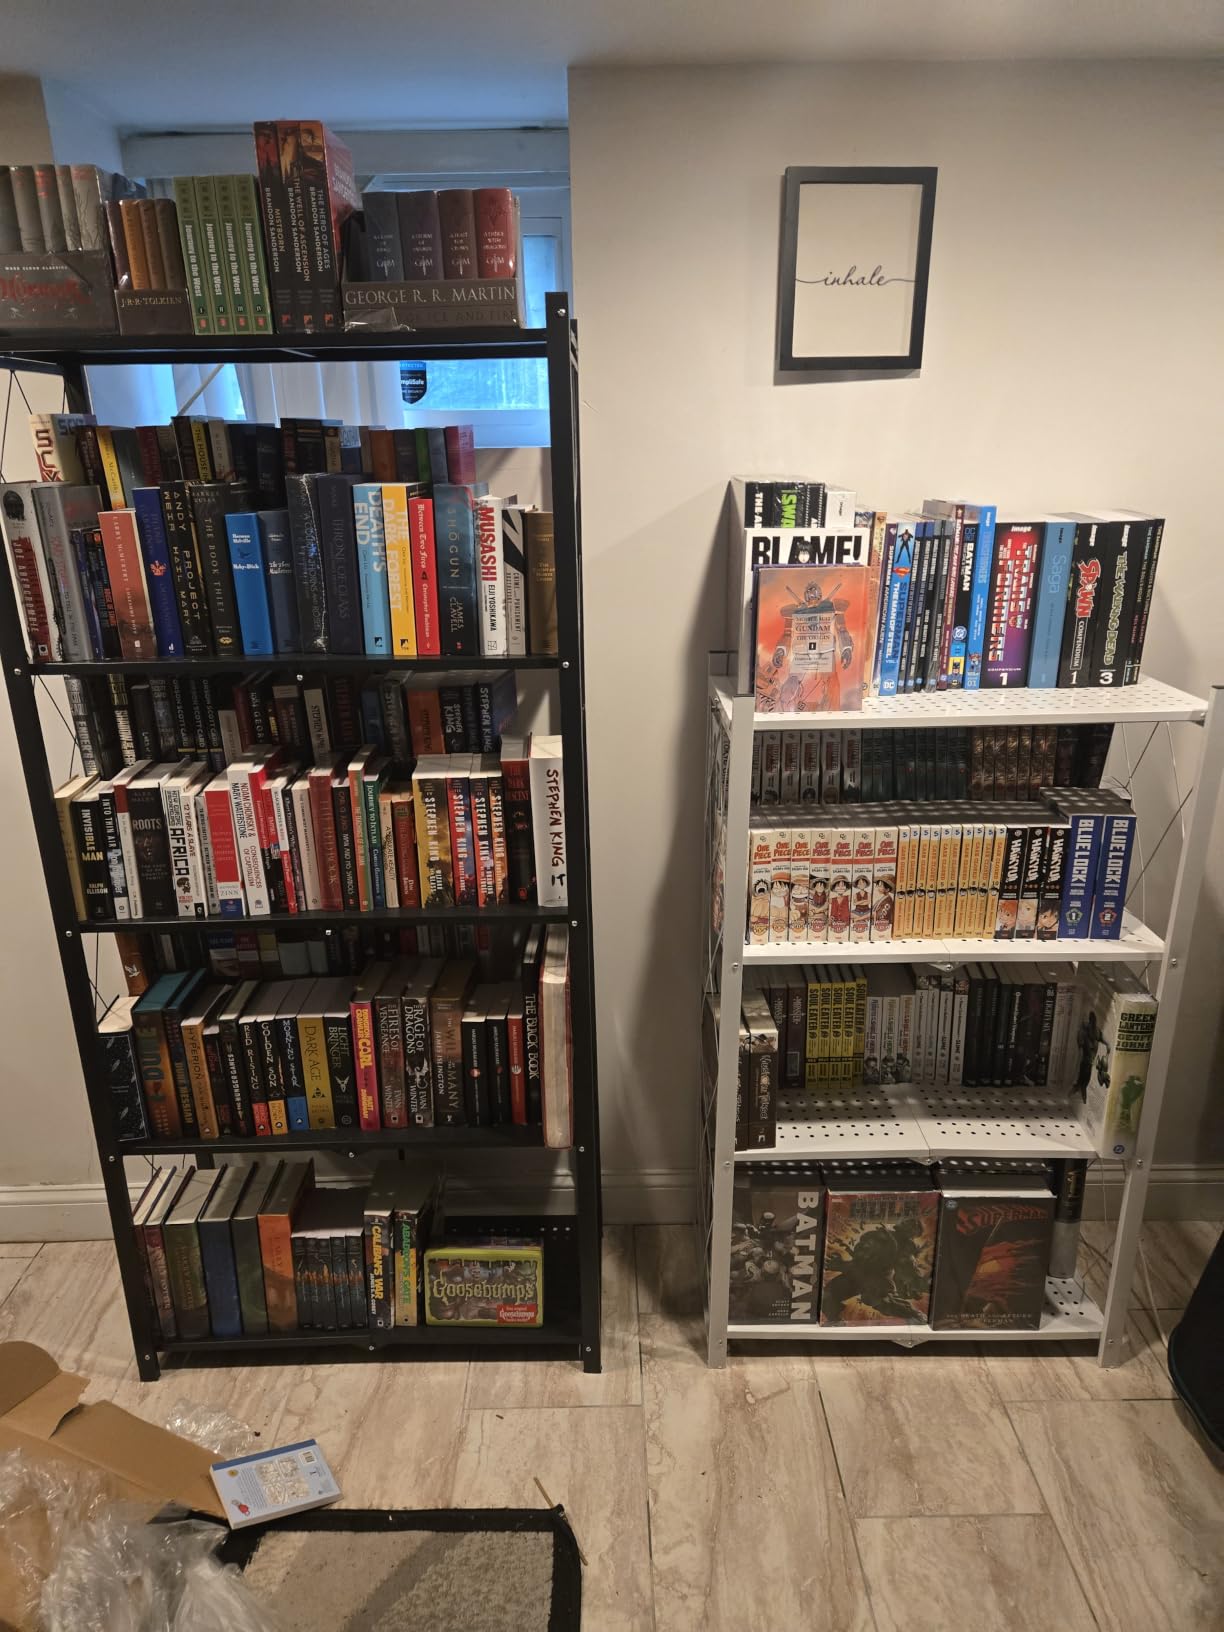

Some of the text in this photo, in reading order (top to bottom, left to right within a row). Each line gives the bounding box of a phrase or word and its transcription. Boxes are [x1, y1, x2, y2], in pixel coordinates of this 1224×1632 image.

[265, 187, 281, 273] BRANDON SANDERSON
[274, 208, 286, 252] MISTBORN
[287, 187, 303, 273] BRANDON SANDERSON
[310, 186, 324, 272] BRANDON SANDERSON
[204, 223, 222, 295] Journey West
[224, 223, 242, 295] Journey West
[244, 223, 261, 295] Journey West
[300, 234, 312, 282] ASCENSION
[323, 248, 331, 269] AGES
[345, 285, 517, 306] GEORGE R. R. MARTIN
[162, 490, 176, 531] WEIR
[173, 491, 187, 531] ANDY
[353, 502, 370, 545] END
[754, 492, 764, 513] THE
[367, 490, 386, 573] DEATH'S
[478, 507, 498, 582] MUSASHI
[752, 535, 862, 565] BLAME!
[203, 517, 225, 613] THE BOOK THIEF
[384, 499, 402, 612] DARK FOREST
[885, 545, 896, 586] SUPERMAN
[962, 542, 975, 591] BATMAN
[1048, 554, 1068, 594] Saga
[172, 546, 192, 626] HAIL MARY
[183, 550, 200, 620] PROJECT
[1076, 558, 1101, 619] SPAWN
[449, 596, 459, 632] CLAVELL
[488, 597, 497, 632] YOSHIKAWA
[795, 624, 831, 632] GUNDAM
[894, 581, 908, 659] SUPERMAN
[987, 559, 1014, 662] FORMERS
[1103, 551, 1129, 665] THE WALKING DEAD
[1073, 620, 1085, 667] COMPENDIUM
[882, 681, 895, 689] DC
[999, 672, 1009, 685] 1
[1070, 671, 1078, 684] 1
[1099, 672, 1113, 684] 3
[444, 706, 456, 733] KING
[452, 704, 463, 733] STEPHEN
[480, 687, 493, 752] STEPHEN KING
[101, 798, 115, 848] INTO THIN AIR
[132, 818, 162, 831] ROOTS
[235, 800, 247, 839] WATERSTONE
[240, 783, 254, 830] NOAM CHOMSKY
[453, 794, 468, 858] STEPHEN KING
[491, 795, 505, 858] STEPHEN KING
[546, 769, 565, 867] STEPHEN KING
[81, 809, 95, 852] INVISIBLE
[424, 797, 440, 861] STEPHEN KING
[474, 797, 491, 860] STEPHEN KING
[82, 852, 104, 862] MAN
[170, 828, 189, 876] AFRICA
[774, 849, 791, 857] PIECE
[792, 849, 810, 857] PIECE
[360, 1008, 371, 1038] DUNGEON
[388, 1009, 400, 1040] FIRES
[412, 1008, 425, 1039] RAGE
[808, 989, 818, 1030] SOUL EATER
[821, 988, 830, 1030] SOUL EATER
[833, 987, 842, 1029] SOUL EATER
[844, 987, 854, 1029] SOUL EATER
[855, 983, 866, 1025] SOUL EATER
[1120, 1012, 1156, 1022] GREEN
[282, 1019, 295, 1060] MORNING
[328, 1026, 342, 1069] BRINGER
[338, 1026, 350, 1057] LIGHT
[379, 1006, 390, 1054] VENGEANCE
[403, 1006, 416, 1054] DRAGONS
[525, 994, 539, 1080] THE BLACK BOOK
[187, 1028, 202, 1080] HYPERION
[243, 1024, 260, 1090] RED RISING
[261, 1022, 277, 1088] GOLDEN SON
[303, 1025, 322, 1081] DARK AGE
[358, 1038, 373, 1069] CARL
[436, 1055, 445, 1095] ISLINGTON
[447, 1070, 459, 1109] MANY
[181, 1086, 193, 1123] MESSIAH
[384, 1084, 395, 1113] WINTER
[409, 1085, 418, 1113] WINTER
[419, 1090, 428, 1109] EVAN
[371, 1225, 384, 1300] CALIBAN'S WAR
[790, 1190, 819, 1320] BATMAN
[402, 1279, 411, 1305] GATE
[432, 1270, 536, 1305] Goosebumps
